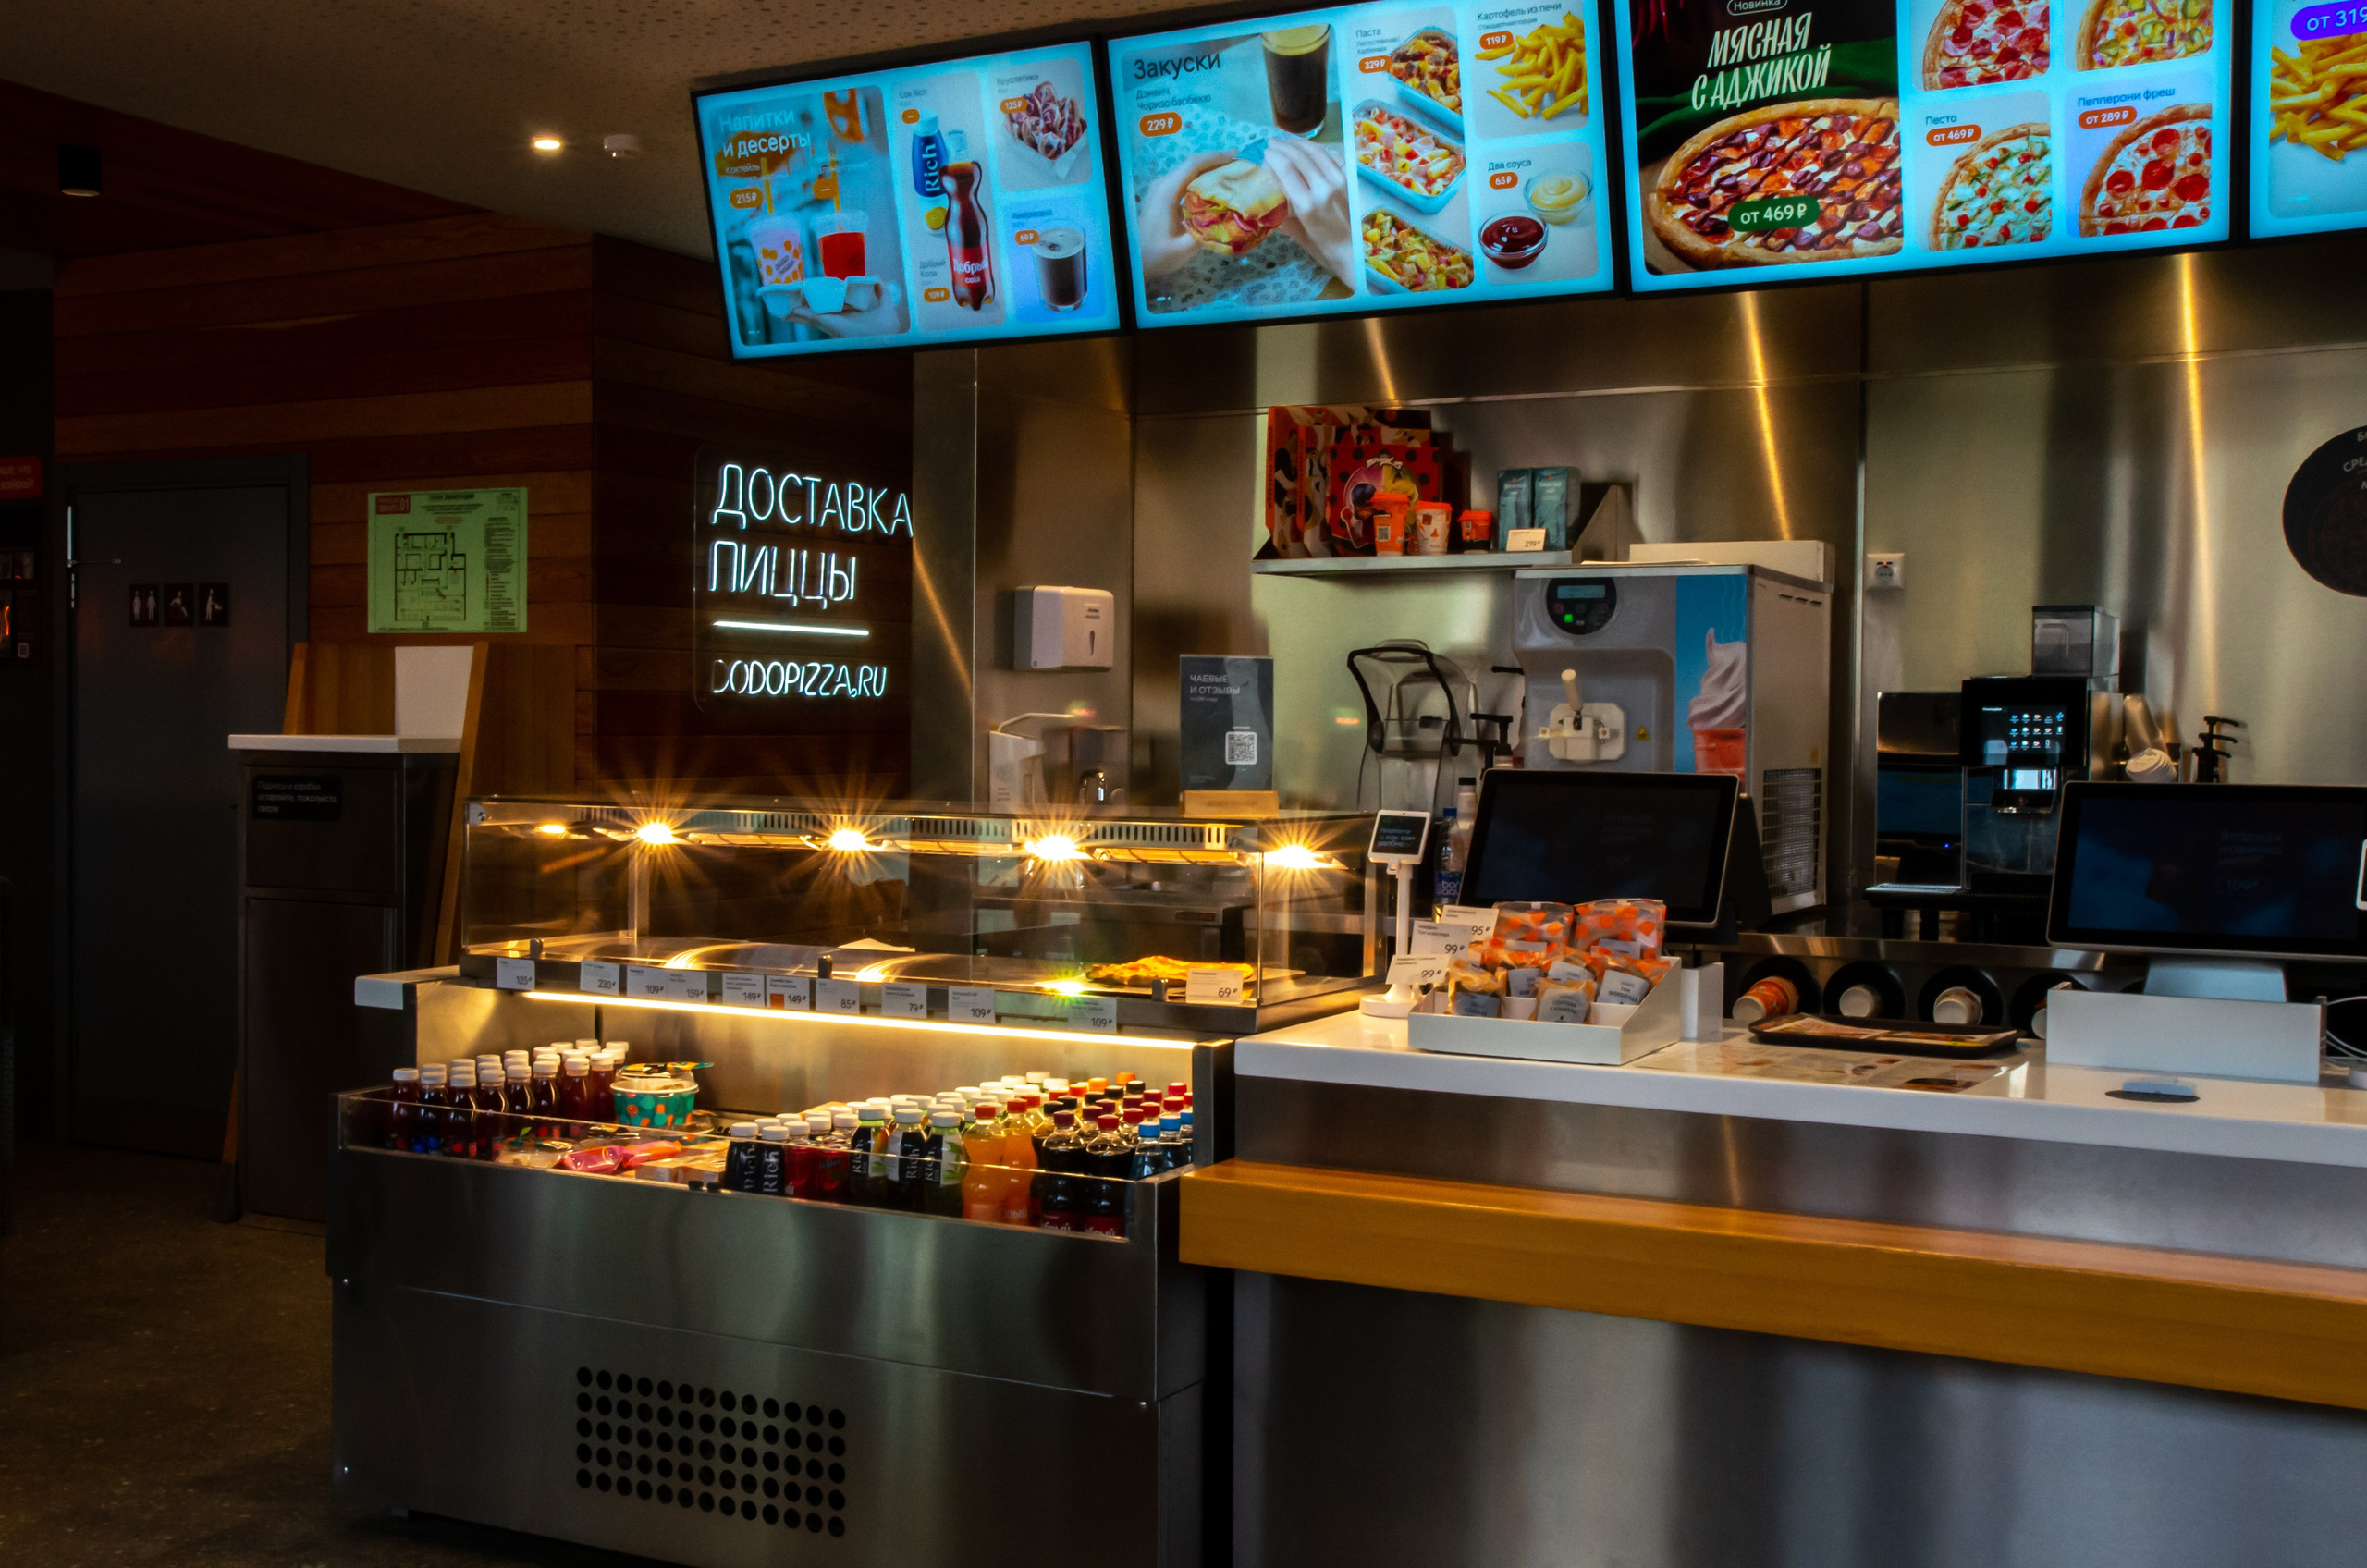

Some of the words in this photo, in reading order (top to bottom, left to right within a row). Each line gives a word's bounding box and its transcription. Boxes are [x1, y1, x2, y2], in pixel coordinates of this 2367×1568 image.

[1478, 8, 1526, 21] Картофель
[1539, 3, 1562, 12] печи
[1734, 0, 1781, 11] Новинка
[2306, 16, 2330, 31] от
[2335, 6, 2367, 27] 319
[1355, 29, 1381, 38] Паста
[1707, 11, 1812, 69] МЯСНАЯ
[1134, 53, 1220, 80] Закуски
[1691, 74, 1708, 111] С
[1711, 43, 1832, 111] АДЖИКОЙ
[1137, 101, 1170, 111] Чоризо
[1171, 94, 1211, 107] барбекю
[2078, 92, 2141, 107] Пепперони
[2143, 88, 2176, 101] фреш
[718, 110, 795, 133] Напитки
[1925, 115, 1957, 126] Песто
[2086, 116, 2098, 125] от
[723, 142, 734, 157] и
[737, 132, 811, 158] десерты
[1933, 133, 1945, 142] от
[923, 143, 941, 192] Rich
[1488, 162, 1505, 171] Два
[1506, 159, 1532, 169] соуса
[1740, 211, 1760, 225] от
[710, 463, 914, 538] ДОСТАВКА
[708, 540, 857, 610] ПИЦЦЫ
[712, 658, 888, 698] DODOPIZZA.RU
[1189, 674, 1228, 683] ЧАЕВЫЕ
[1189, 686, 1197, 694] И
[1198, 686, 1241, 695] ОТЗЫВЫ
[763, 1150, 779, 1193] Rich
